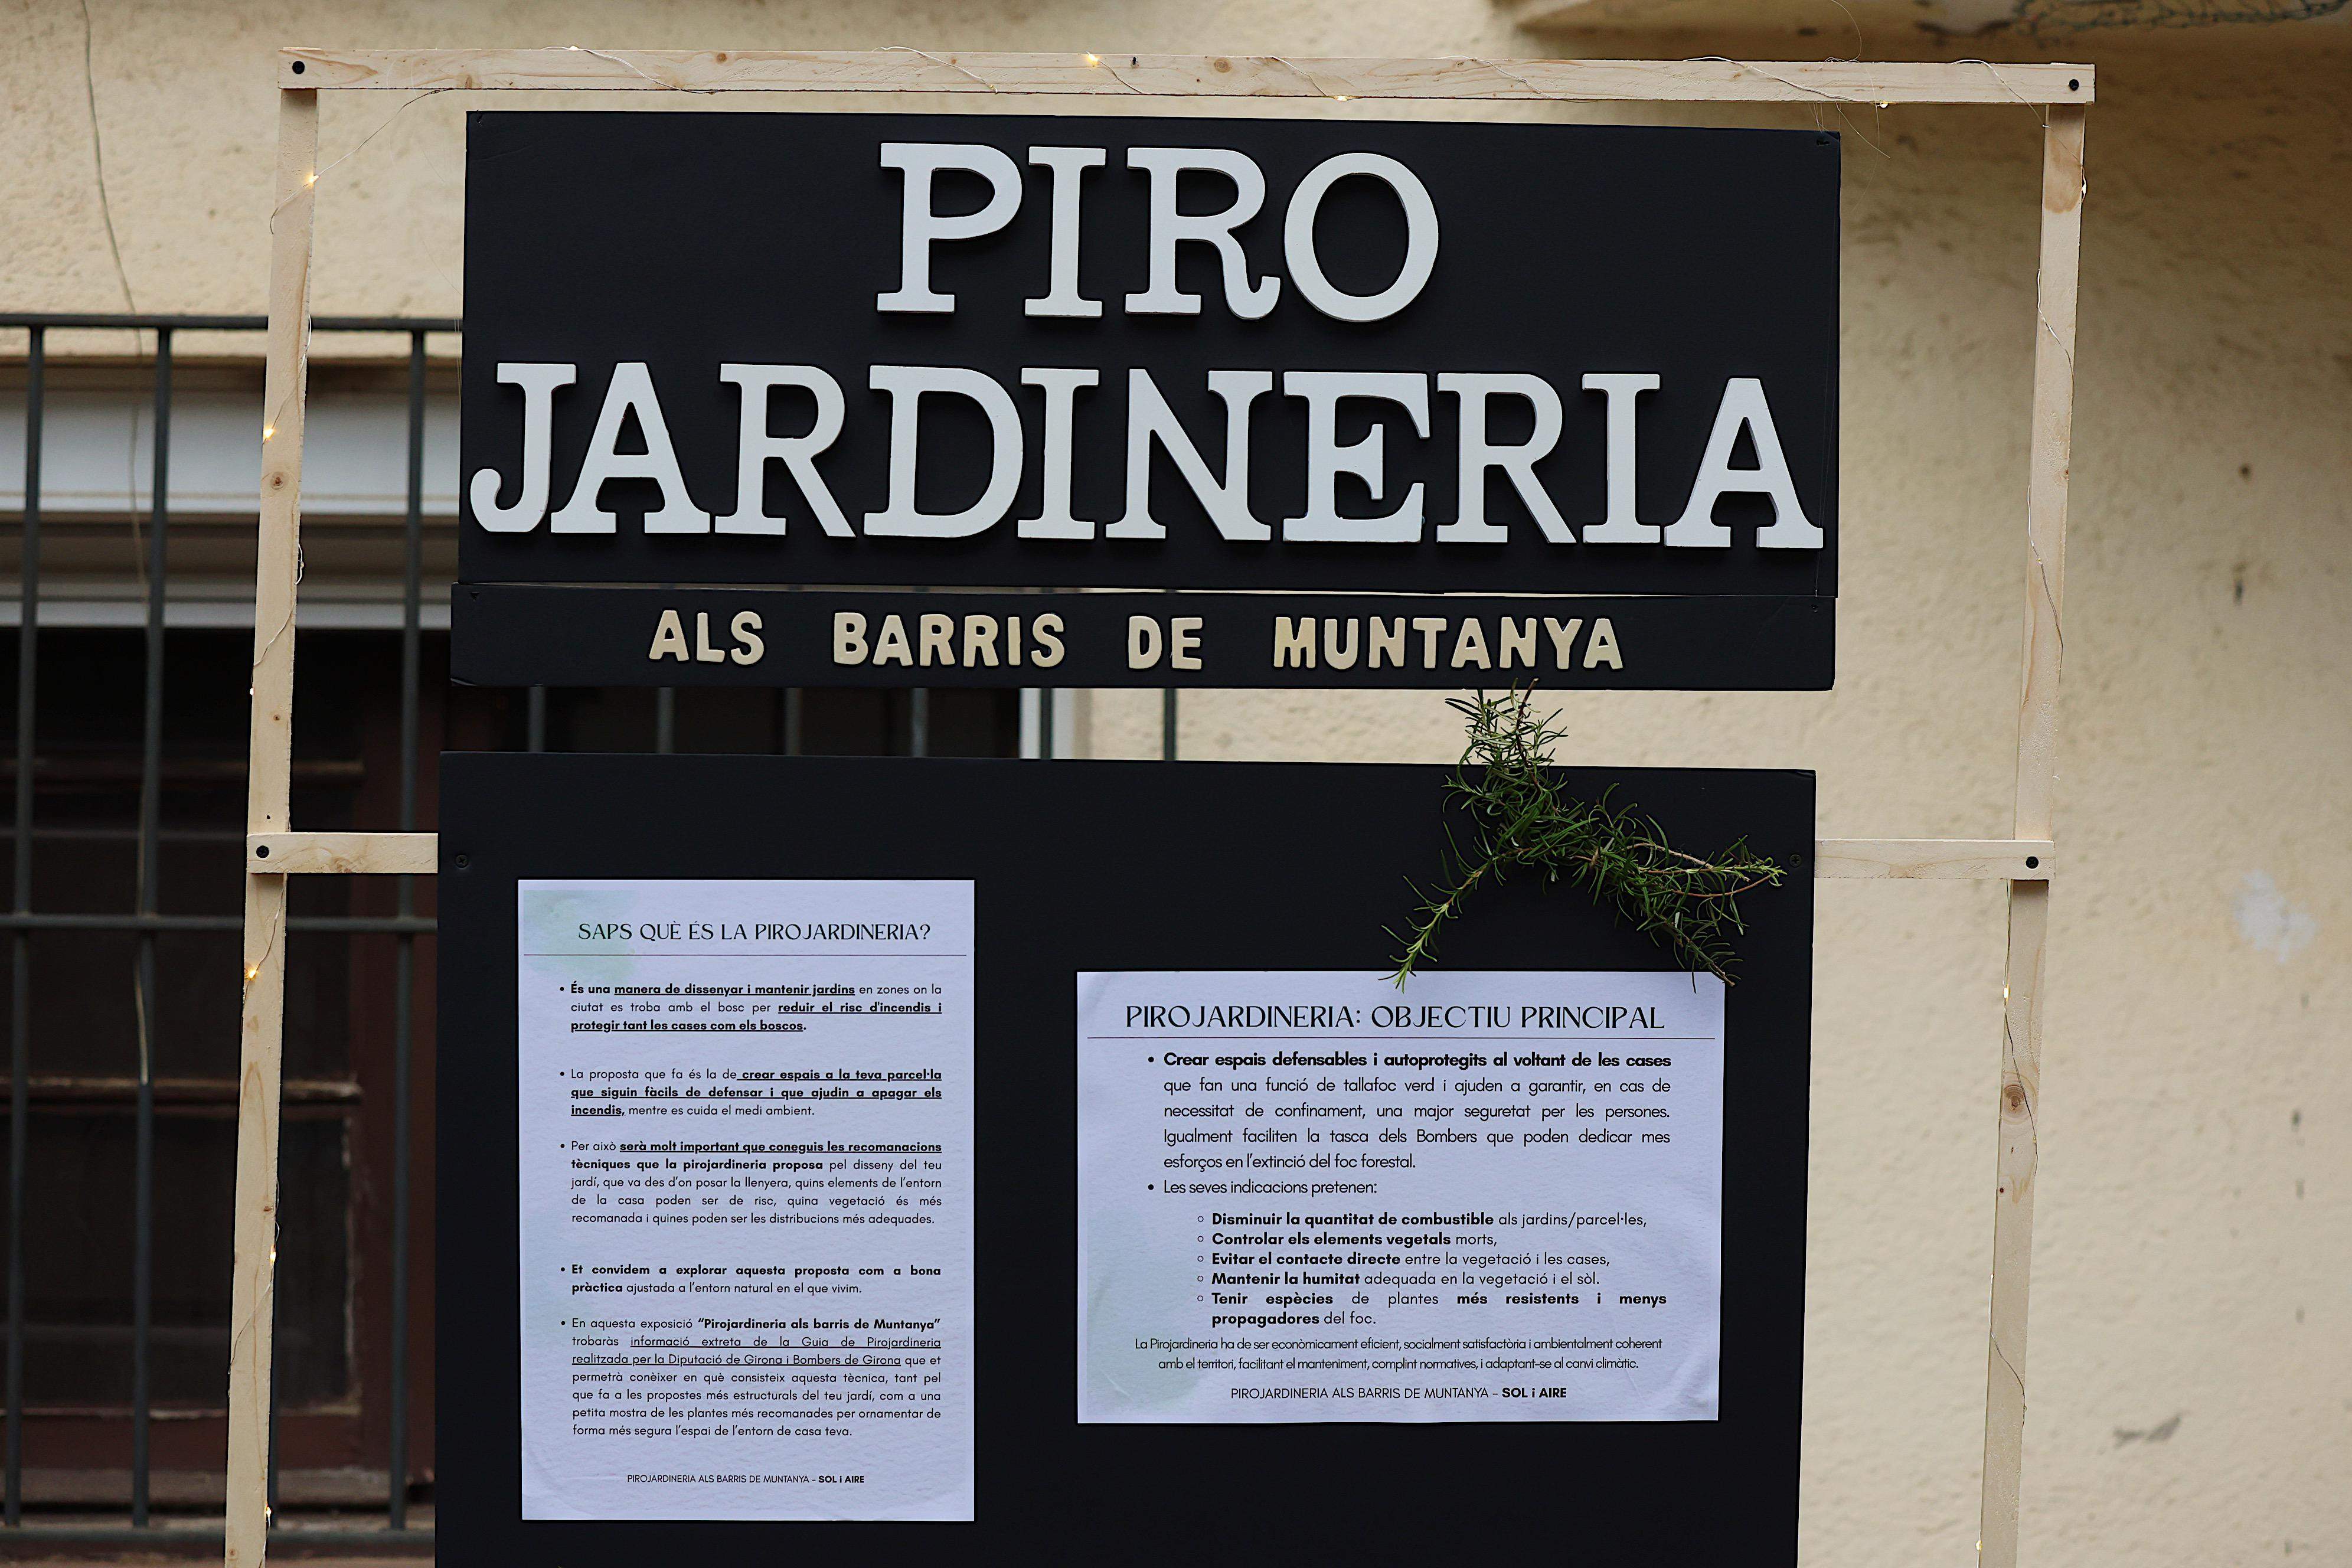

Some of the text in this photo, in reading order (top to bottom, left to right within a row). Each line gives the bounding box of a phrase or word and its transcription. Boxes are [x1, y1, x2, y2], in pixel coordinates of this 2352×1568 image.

[877, 142, 1439, 321] PIRO
[470, 361, 1824, 549] JARDINERIA
[649, 610, 1623, 670] ALS BARRIS DE MUNTANYA
[577, 920, 932, 942] SAPS QUÈ ÉS LA PIROJARDINERIA?
[570, 979, 942, 998] És una manera de dissenyar i mantenir jardins en zones on la
[570, 1018, 808, 1034] protegir tant les cases com els boscos.
[1125, 1005, 1665, 1030] PIROJARDINERIA: OBJECTIU PRINCIPAL
[1163, 1050, 1672, 1072] Crear espais defensables i autoprotegits al voltant de les cases
[570, 1103, 815, 1118] incendis, mentre es cuida el medi ambient.
[1164, 1126, 1671, 1148] Igualment faciliten la tasca dels Bombers que poden dedicar mes
[570, 1157, 942, 1174] tècniques que la pirojardineria proposa pel disseny del teu
[1163, 1177, 1378, 1198] Les seves indicacions pretenen:
[1211, 1212, 1283, 1226] Disminuir
[1286, 1211, 1301, 1226] la
[1304, 1212, 1375, 1230] quantitat
[1377, 1211, 1398, 1226] de
[1400, 1211, 1495, 1226] combustible
[1498, 1211, 1518, 1226] als
[1211, 1230, 1498, 1249] Controlar els elements vegetals morts,
[571, 1263, 942, 1279] Et convidem a explorar aquesta proposta com a bona
[1211, 1270, 1600, 1289] Mantenir la humitat adequada en la vegetació i el sòl.
[1210, 1290, 1668, 1309] Tenir espècies de plantes més resistents i menys
[1211, 1310, 1377, 1329] propagadores del foc.
[571, 1334, 942, 1350] trobaràs informació extreta de la Guia de Pirojardineria
[571, 1371, 942, 1387] permetrà conèixer en què consisteix aquesta tècnica, tant pel
[1230, 1387, 1329, 1400] PIROJARDINERIA
[1331, 1386, 1355, 1399] ALS
[1358, 1386, 1402, 1399] BARRIS
[1404, 1387, 1421, 1399] DE
[1423, 1386, 1489, 1399] MUNTANYA
[1501, 1386, 1529, 1399] SOL
[1531, 1387, 1536, 1399] i
[1538, 1387, 1567, 1399] AIRE
[571, 1423, 606, 1436] forma
[608, 1424, 632, 1436] més
[633, 1427, 672, 1439] segura
[713, 1424, 730, 1436] de
[776, 1424, 792, 1436] de
[794, 1428, 822, 1436] casa
[824, 1426, 853, 1437] teva.
